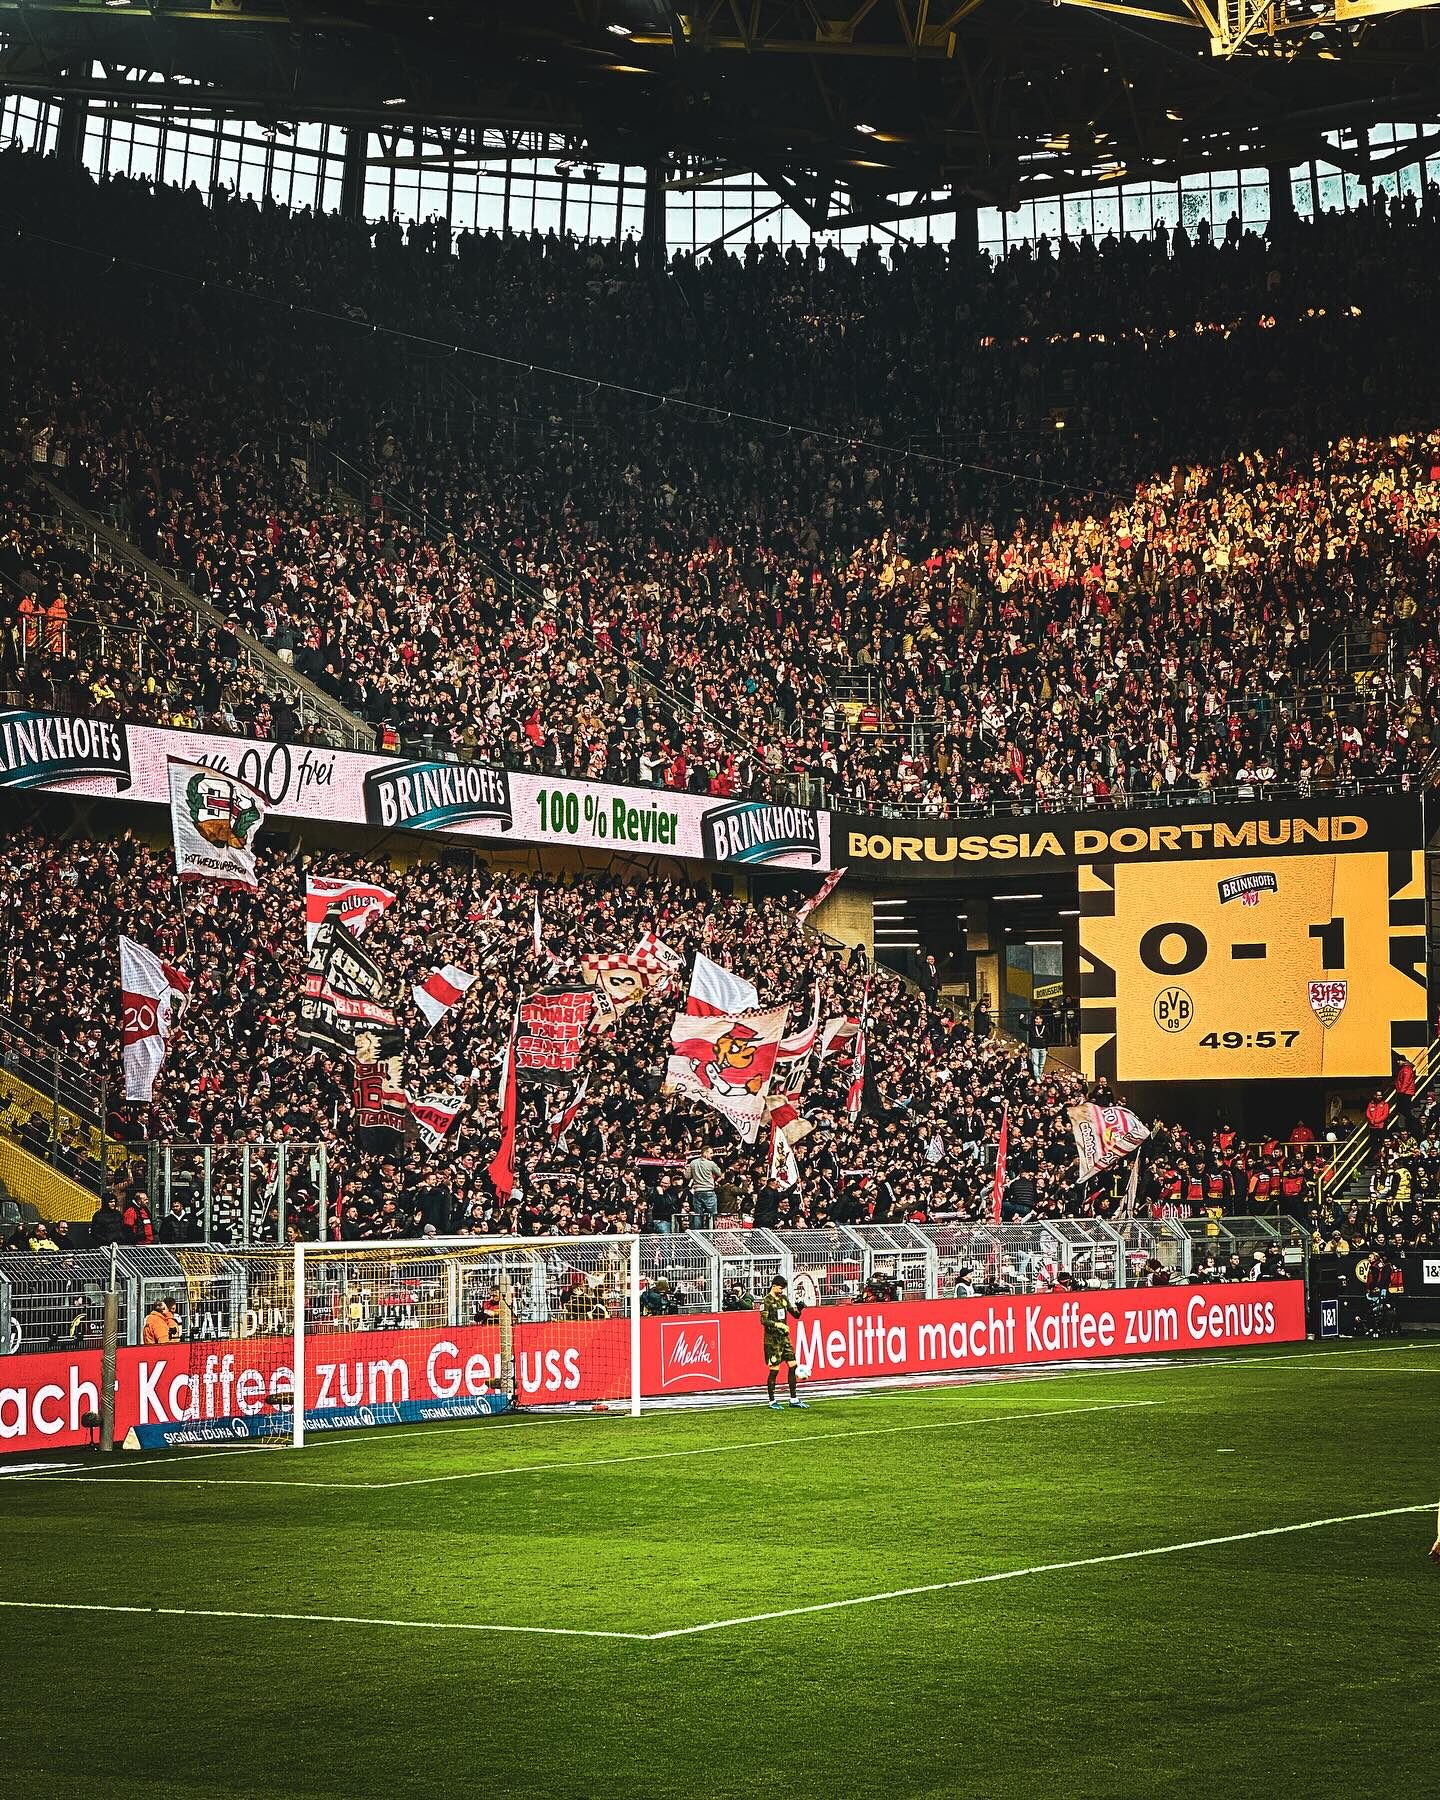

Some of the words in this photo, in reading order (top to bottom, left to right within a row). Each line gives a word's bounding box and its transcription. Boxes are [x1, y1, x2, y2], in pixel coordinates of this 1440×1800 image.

[297, 750, 336, 802] frei
[378, 766, 505, 827] BRINKHOFF's
[536, 789, 579, 835] 100
[584, 794, 607, 838] %
[613, 798, 678, 845] Revier
[712, 806, 815, 861] BRINKHOFF's
[848, 832, 1066, 862] BORUSSIA
[1074, 815, 1369, 855] DORTMUND
[1139, 922, 1208, 976] 0
[1309, 917, 1345, 970] 1
[124, 1004, 155, 1032] 20
[1158, 991, 1191, 1021] BVB
[1167, 1018, 1180, 1030] 09
[1198, 1030, 1300, 1050] 49:57
[796, 1314, 906, 1369] Melitta
[918, 1306, 1016, 1361] macht
[1025, 1302, 1116, 1352] Kaffee
[1124, 1306, 1178, 1344] zum
[1187, 1294, 1275, 1341] Genuss
[1322, 1308, 1336, 1327] 1&1
[668, 1330, 713, 1368] Melitta
[0, 1365, 118, 1439] ach
[138, 1353, 295, 1426] Kaffee
[315, 1358, 410, 1409] zum
[419, 1407, 450, 1420] SIGNAL
[450, 1404, 479, 1417] IDUNA
[163, 1428, 201, 1444] SIGNAL
[201, 1426, 234, 1442] IDUNA
[302, 1418, 333, 1431] IGNAL
[333, 1414, 361, 1428] IDUNA
